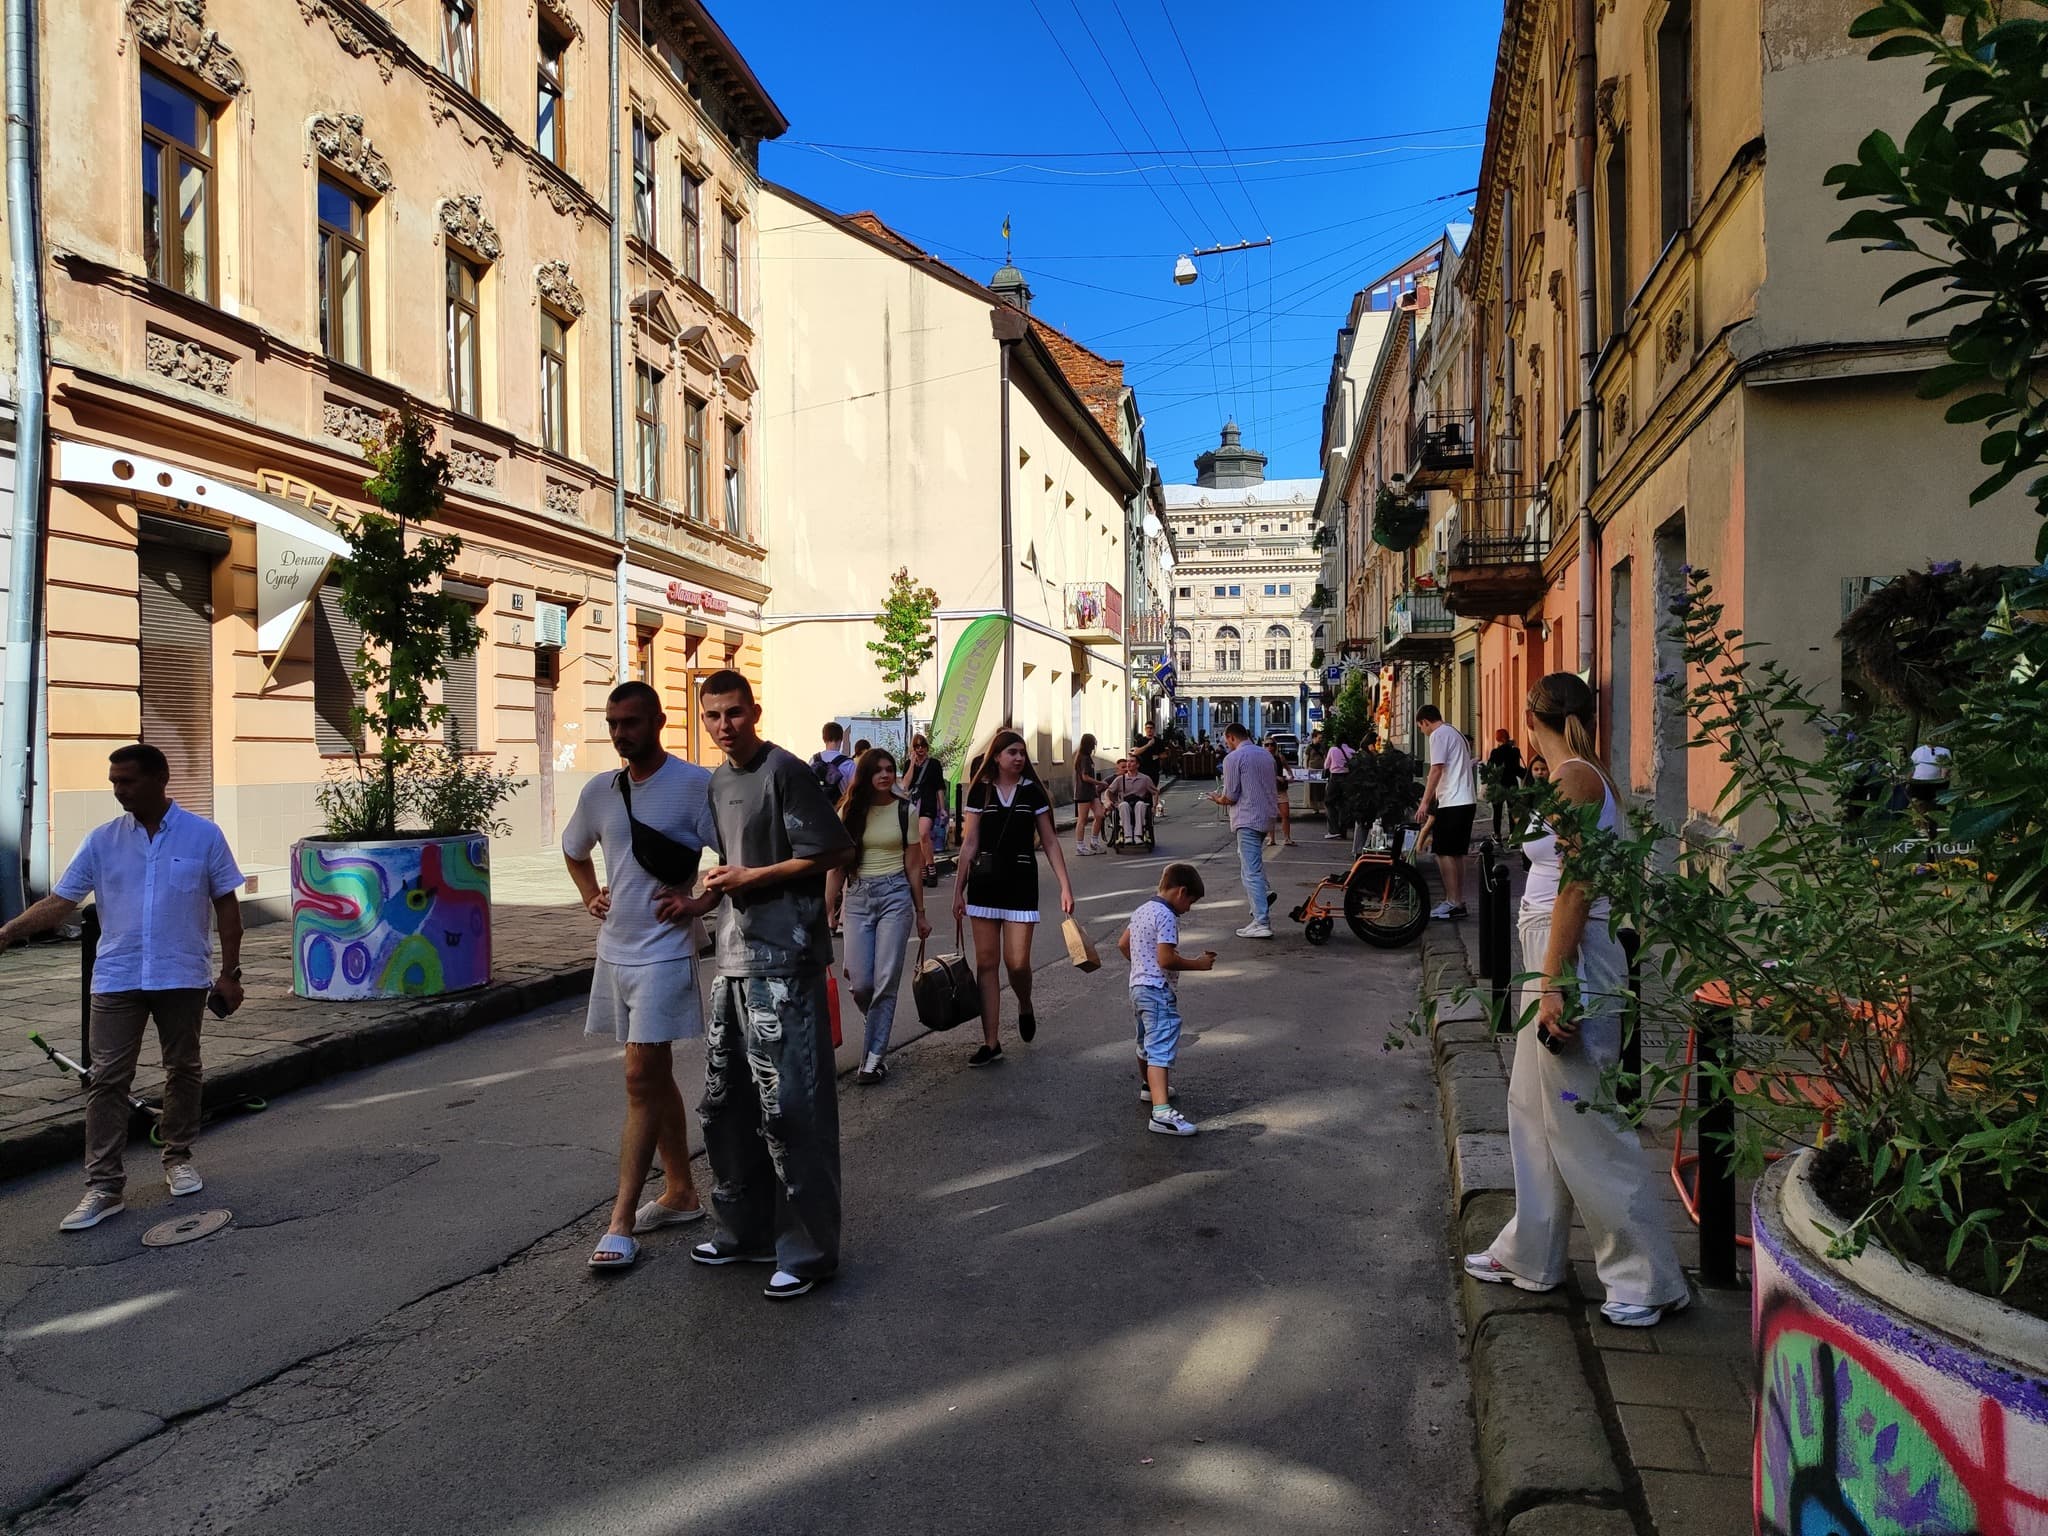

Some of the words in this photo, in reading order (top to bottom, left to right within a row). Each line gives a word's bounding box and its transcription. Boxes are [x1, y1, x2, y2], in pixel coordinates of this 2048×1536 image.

[280, 550, 325, 567] Дента
[265, 568, 300, 590] Супер
[513, 594, 523, 609] 12
[1330, 668, 1337, 677] P
